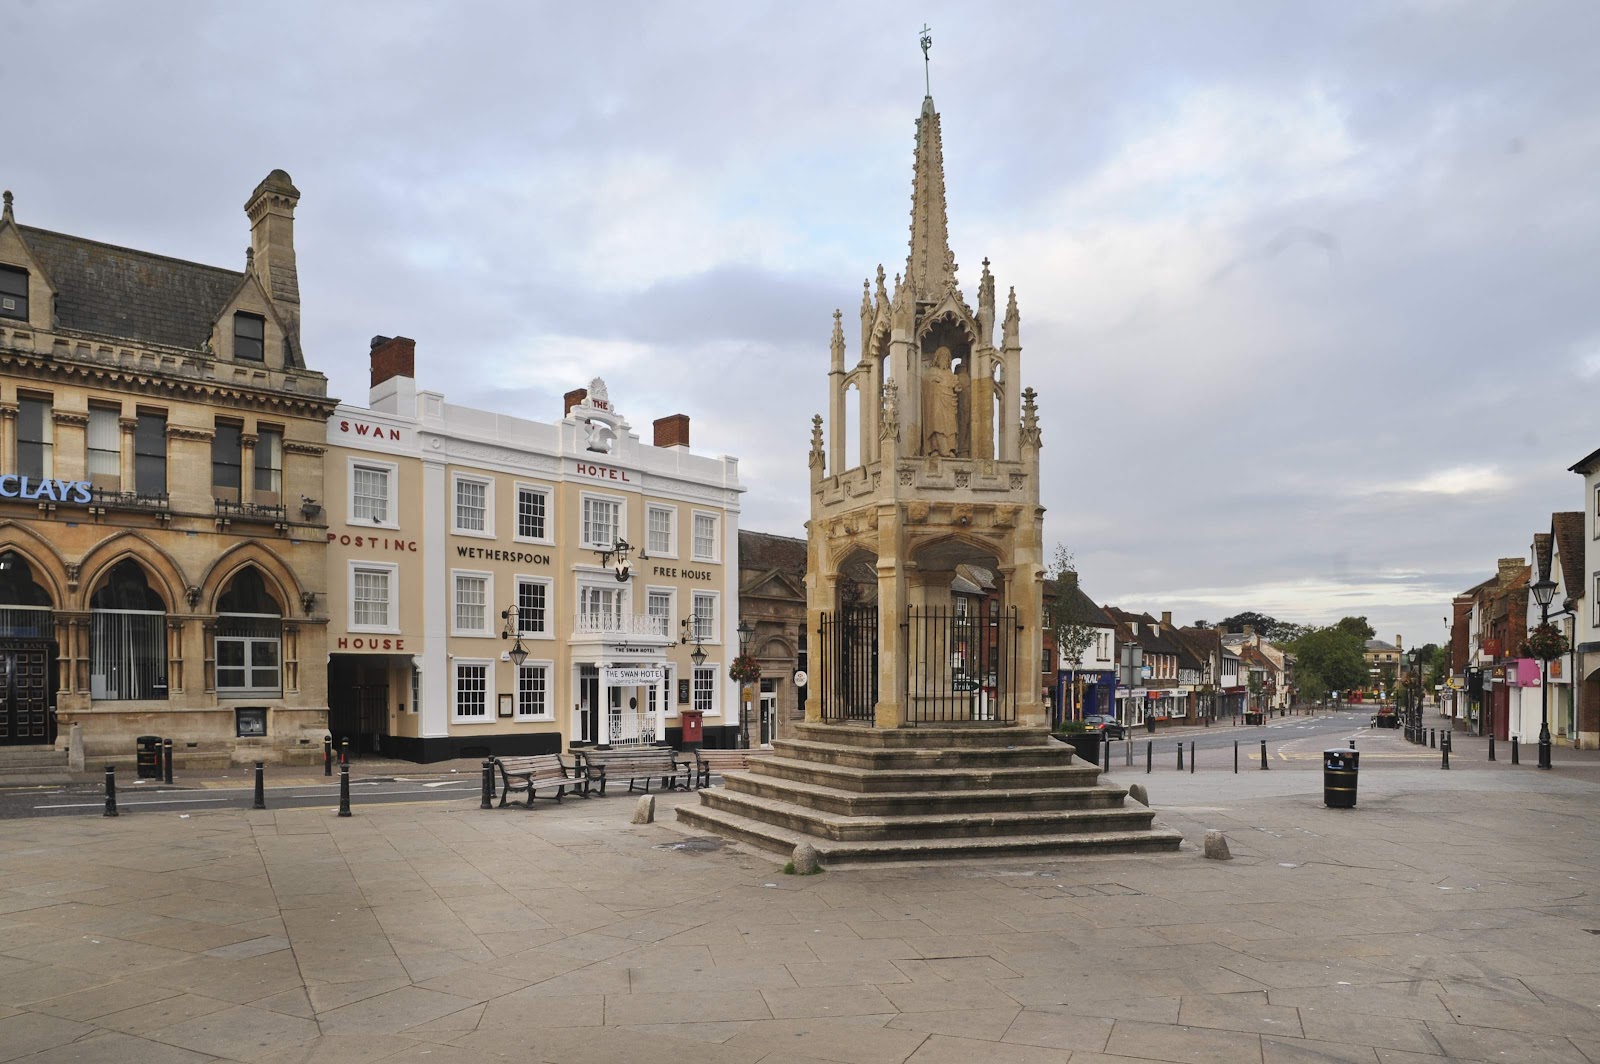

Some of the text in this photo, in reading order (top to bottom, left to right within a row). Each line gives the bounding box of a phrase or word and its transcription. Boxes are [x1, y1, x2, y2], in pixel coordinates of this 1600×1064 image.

[592, 399, 608, 410] THE
[340, 420, 402, 441] SWAN
[577, 463, 630, 482] HOTEL
[0, 474, 93, 504] CLAYS
[327, 533, 418, 553] POSTING
[457, 545, 551, 566] WETHERSPOON
[653, 566, 712, 581] FREE HOUSE
[338, 637, 405, 651] HOUSE
[606, 670, 664, 678] THE SWAN HOTEL
